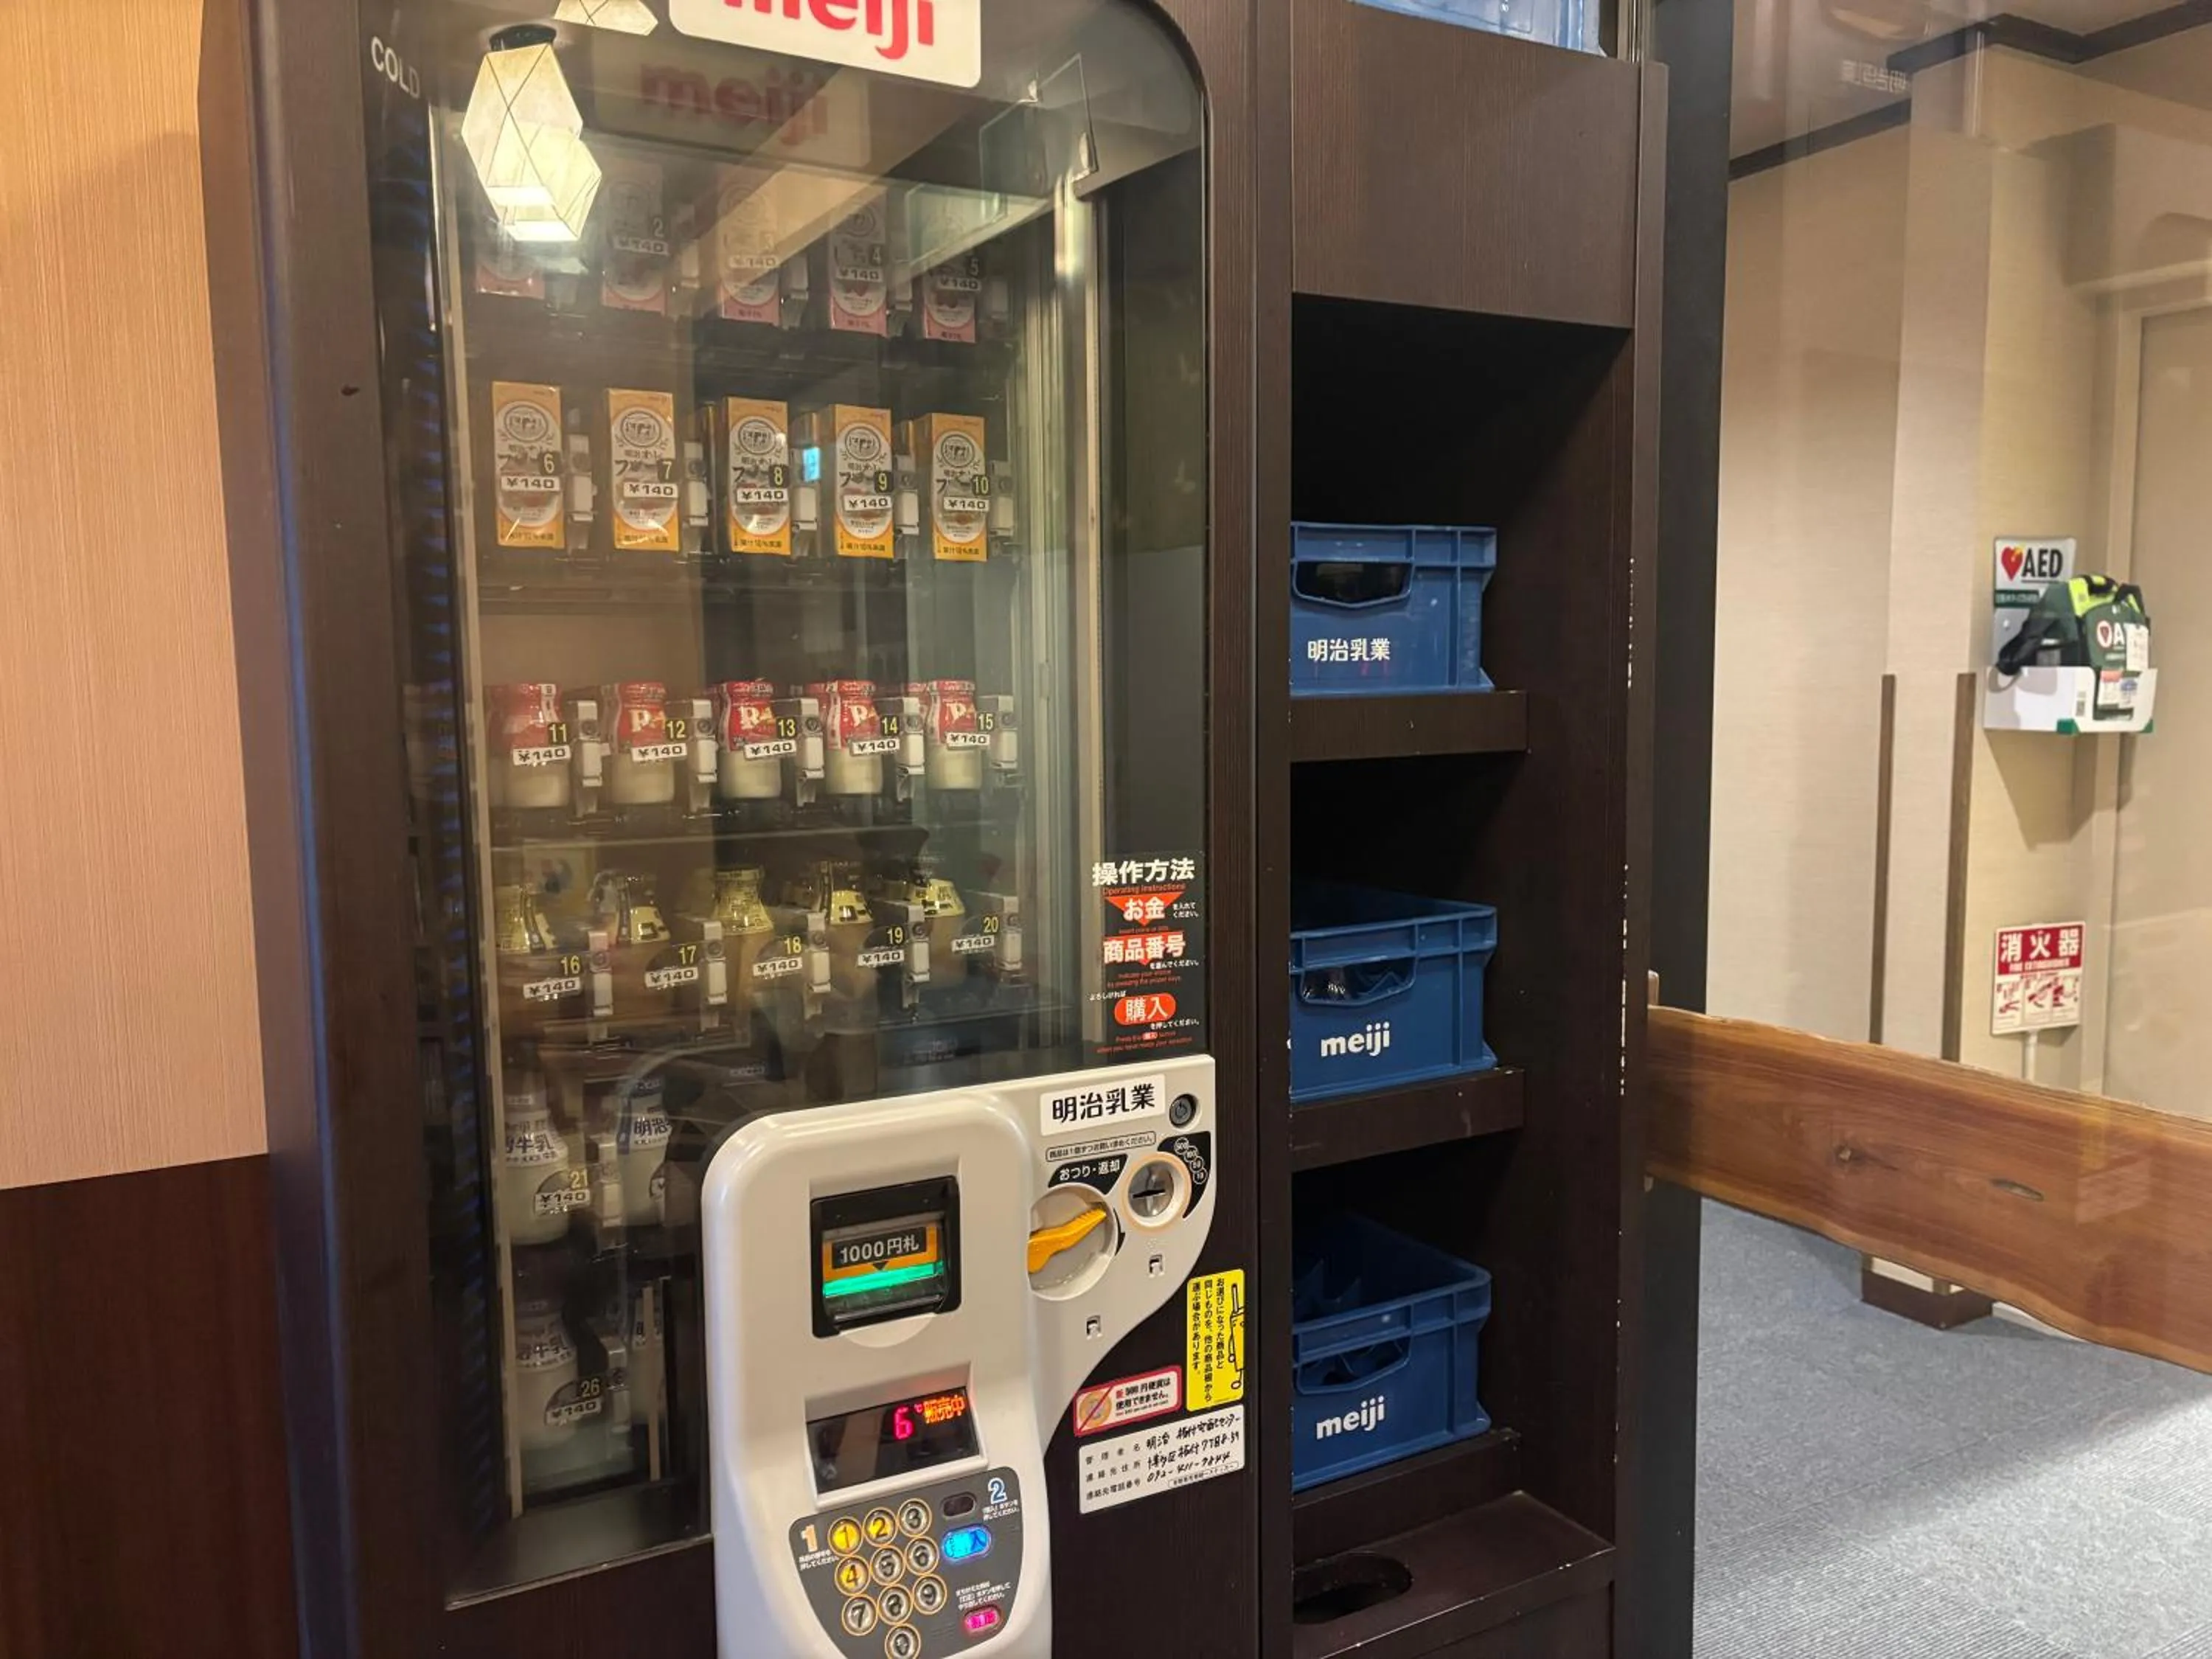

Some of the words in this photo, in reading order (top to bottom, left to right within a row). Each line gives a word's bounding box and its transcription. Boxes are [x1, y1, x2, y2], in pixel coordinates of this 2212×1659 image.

[723, 0, 933, 60] eiji
[372, 36, 420, 99] COLD
[543, 453, 555, 473] 6
[661, 461, 672, 479] 7
[773, 467, 783, 485] 8
[877, 473, 887, 491] 9
[972, 476, 990, 493] 10
[2021, 548, 2063, 579] AED
[1307, 638, 1391, 661] 明治乳業
[666, 720, 687, 739] 12
[778, 718, 796, 737] 13
[881, 717, 898, 734] 14
[978, 712, 994, 731] 15
[549, 723, 568, 743] 11
[1092, 858, 1195, 886] 操作方法
[1124, 897, 1166, 921] お金
[887, 926, 904, 945] 19
[983, 917, 999, 933] 20
[678, 945, 698, 964] 17
[784, 936, 802, 955] 18
[1103, 932, 1186, 964] 商品番号
[2000, 929, 2079, 963] 消火器
[560, 955, 581, 975] 16
[1125, 997, 1169, 1023] 購入
[1321, 1021, 1390, 1057] meiji
[1052, 1083, 1155, 1123] 明治乳業
[570, 1169, 588, 1189] 21
[1060, 1159, 1121, 1180] おつり・返却
[841, 1234, 919, 1263] 1000円札
[580, 1378, 600, 1397] 26
[1316, 1395, 1384, 1439] meiji
[988, 1478, 1007, 1504] 2
[908, 1507, 922, 1527] 3
[800, 1524, 818, 1553] 1
[873, 1517, 888, 1540] 2
[880, 1555, 895, 1577] 5
[914, 1545, 929, 1568] 6
[846, 1565, 860, 1587] 4
[888, 1593, 903, 1617] 8
[922, 1583, 936, 1606] 9
[852, 1604, 866, 1629] 7
